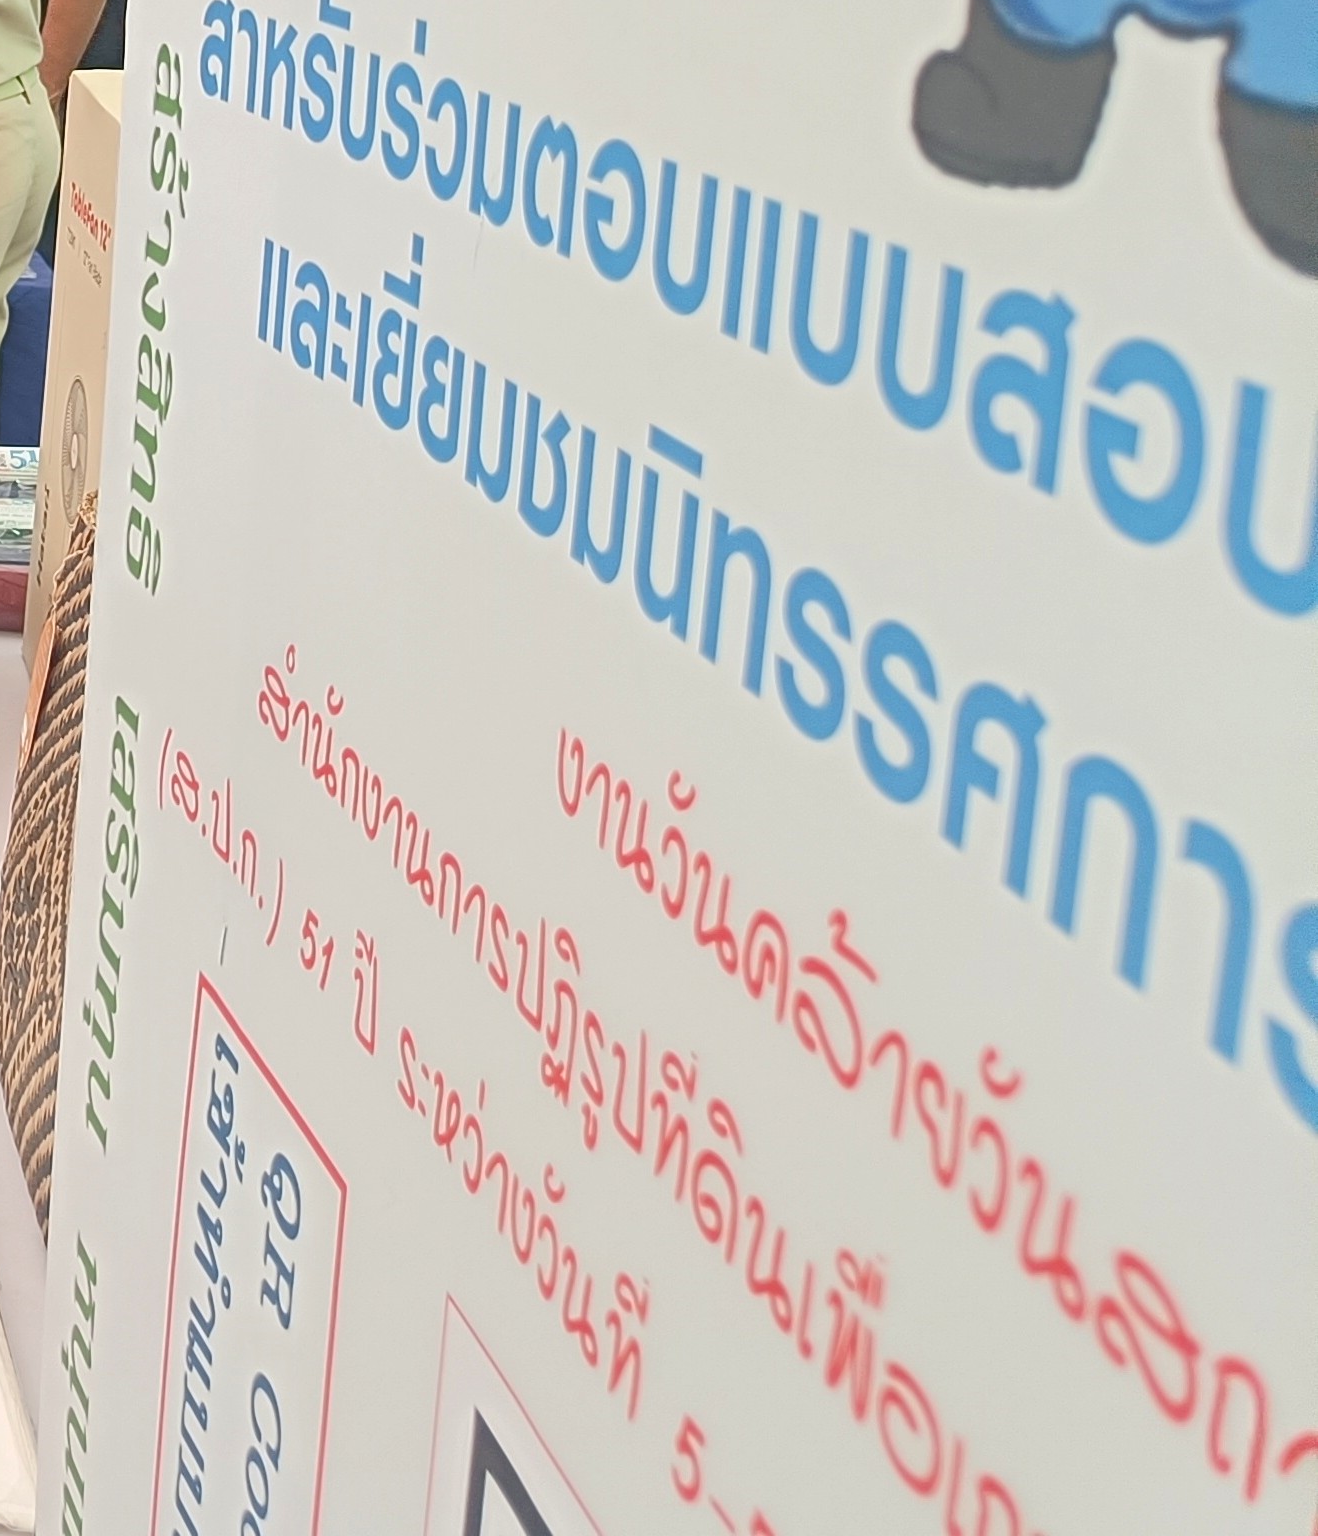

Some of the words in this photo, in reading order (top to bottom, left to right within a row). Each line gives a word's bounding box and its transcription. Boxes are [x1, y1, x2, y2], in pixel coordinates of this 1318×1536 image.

[82, 695, 141, 1156] เสริมทุน
[157, 726, 286, 947] (ส.ป.ก.)
[299, 912, 335, 994] 51
[352, 928, 385, 1058] ปี
[396, 1026, 651, 1422] ระหว่างวันที่
[171, 1031, 247, 1536] เข้าทำแบบ
[240, 1372, 282, 1536] Co
[260, 1151, 302, 1331] QR
